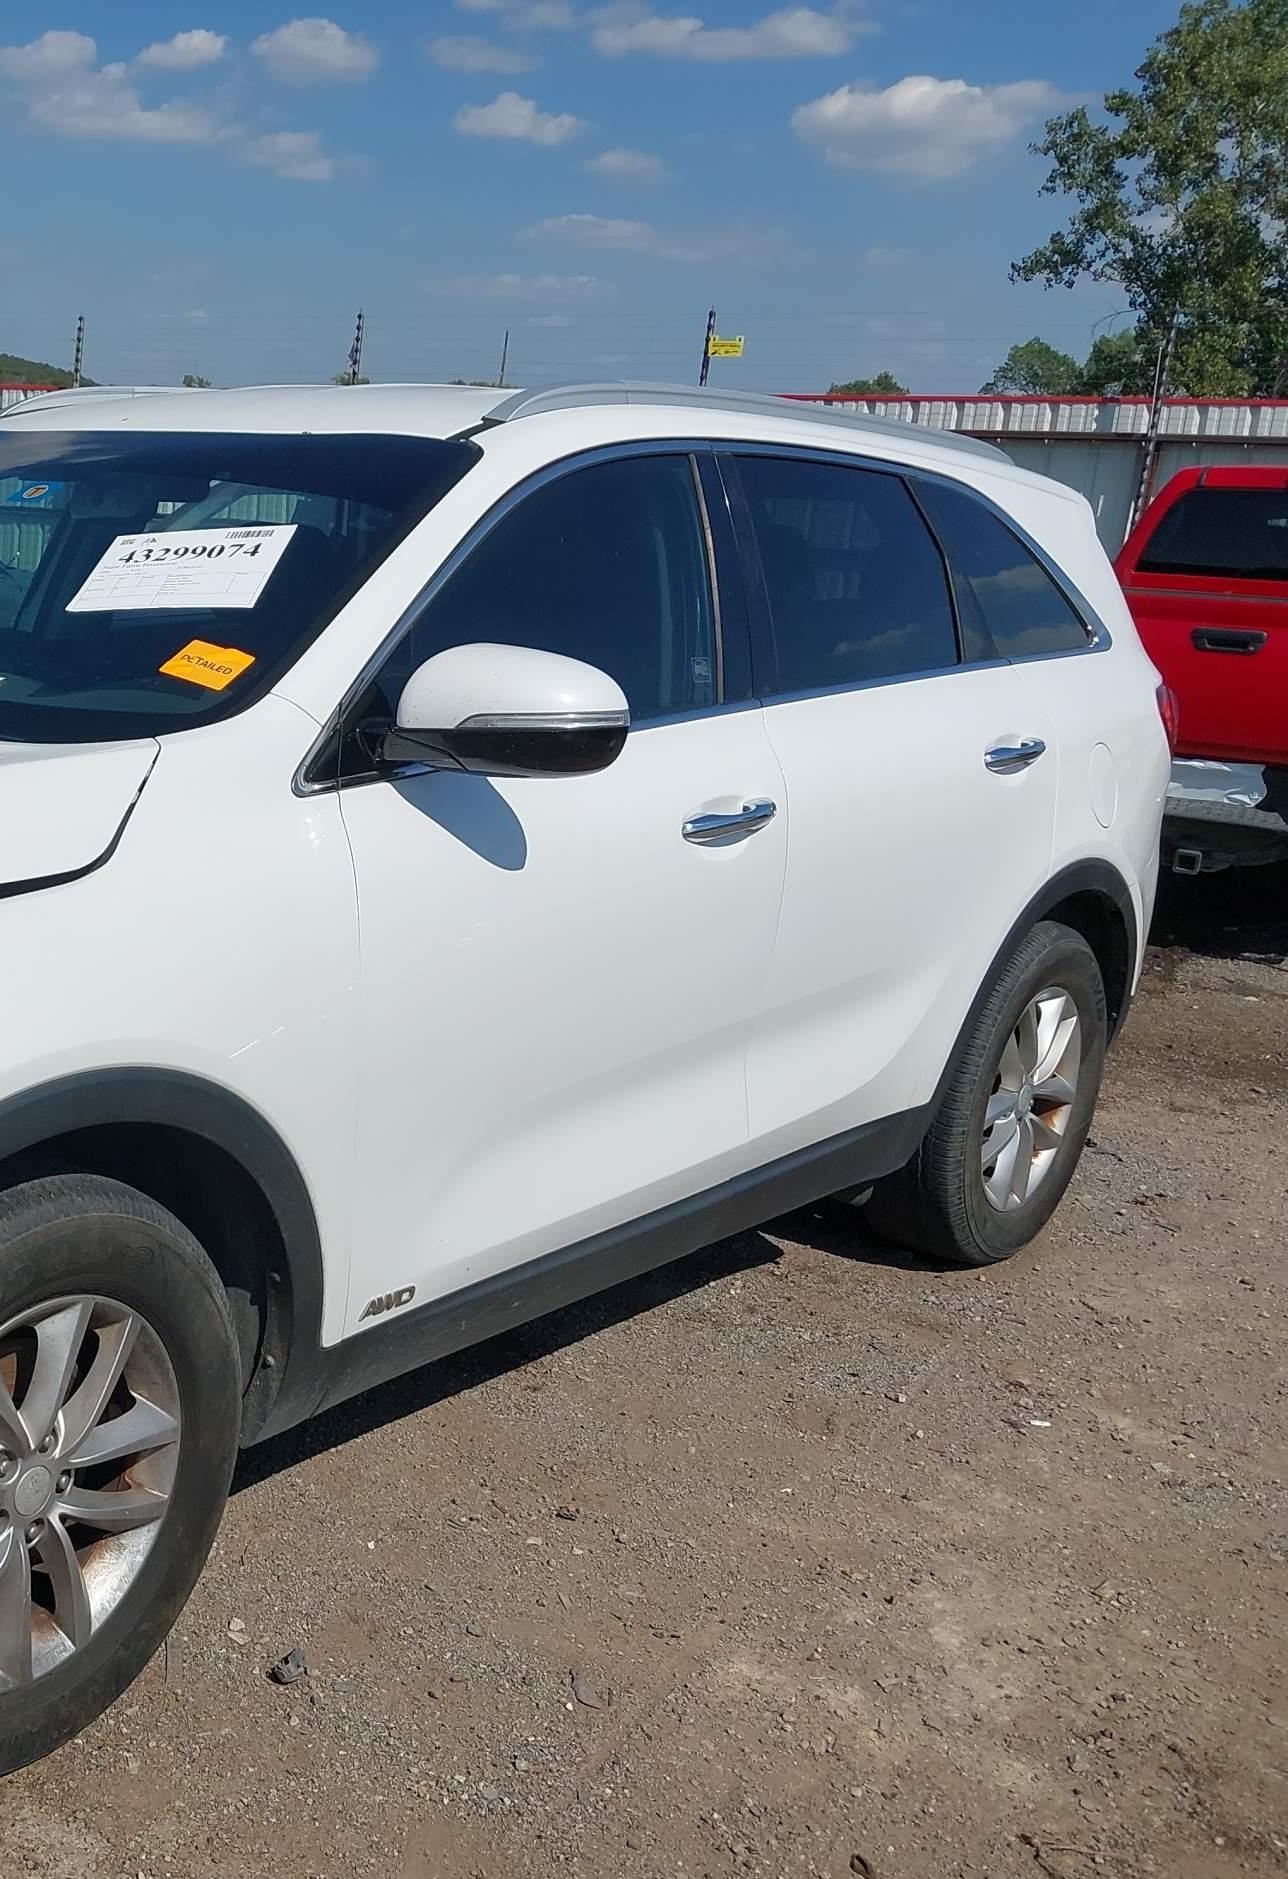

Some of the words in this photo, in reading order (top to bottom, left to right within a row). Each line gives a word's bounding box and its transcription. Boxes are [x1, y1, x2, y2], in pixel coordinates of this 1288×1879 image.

[117, 542, 262, 564] 43299074
[180, 654, 233, 675] DETAILED
[358, 1285, 416, 1322] AWD
